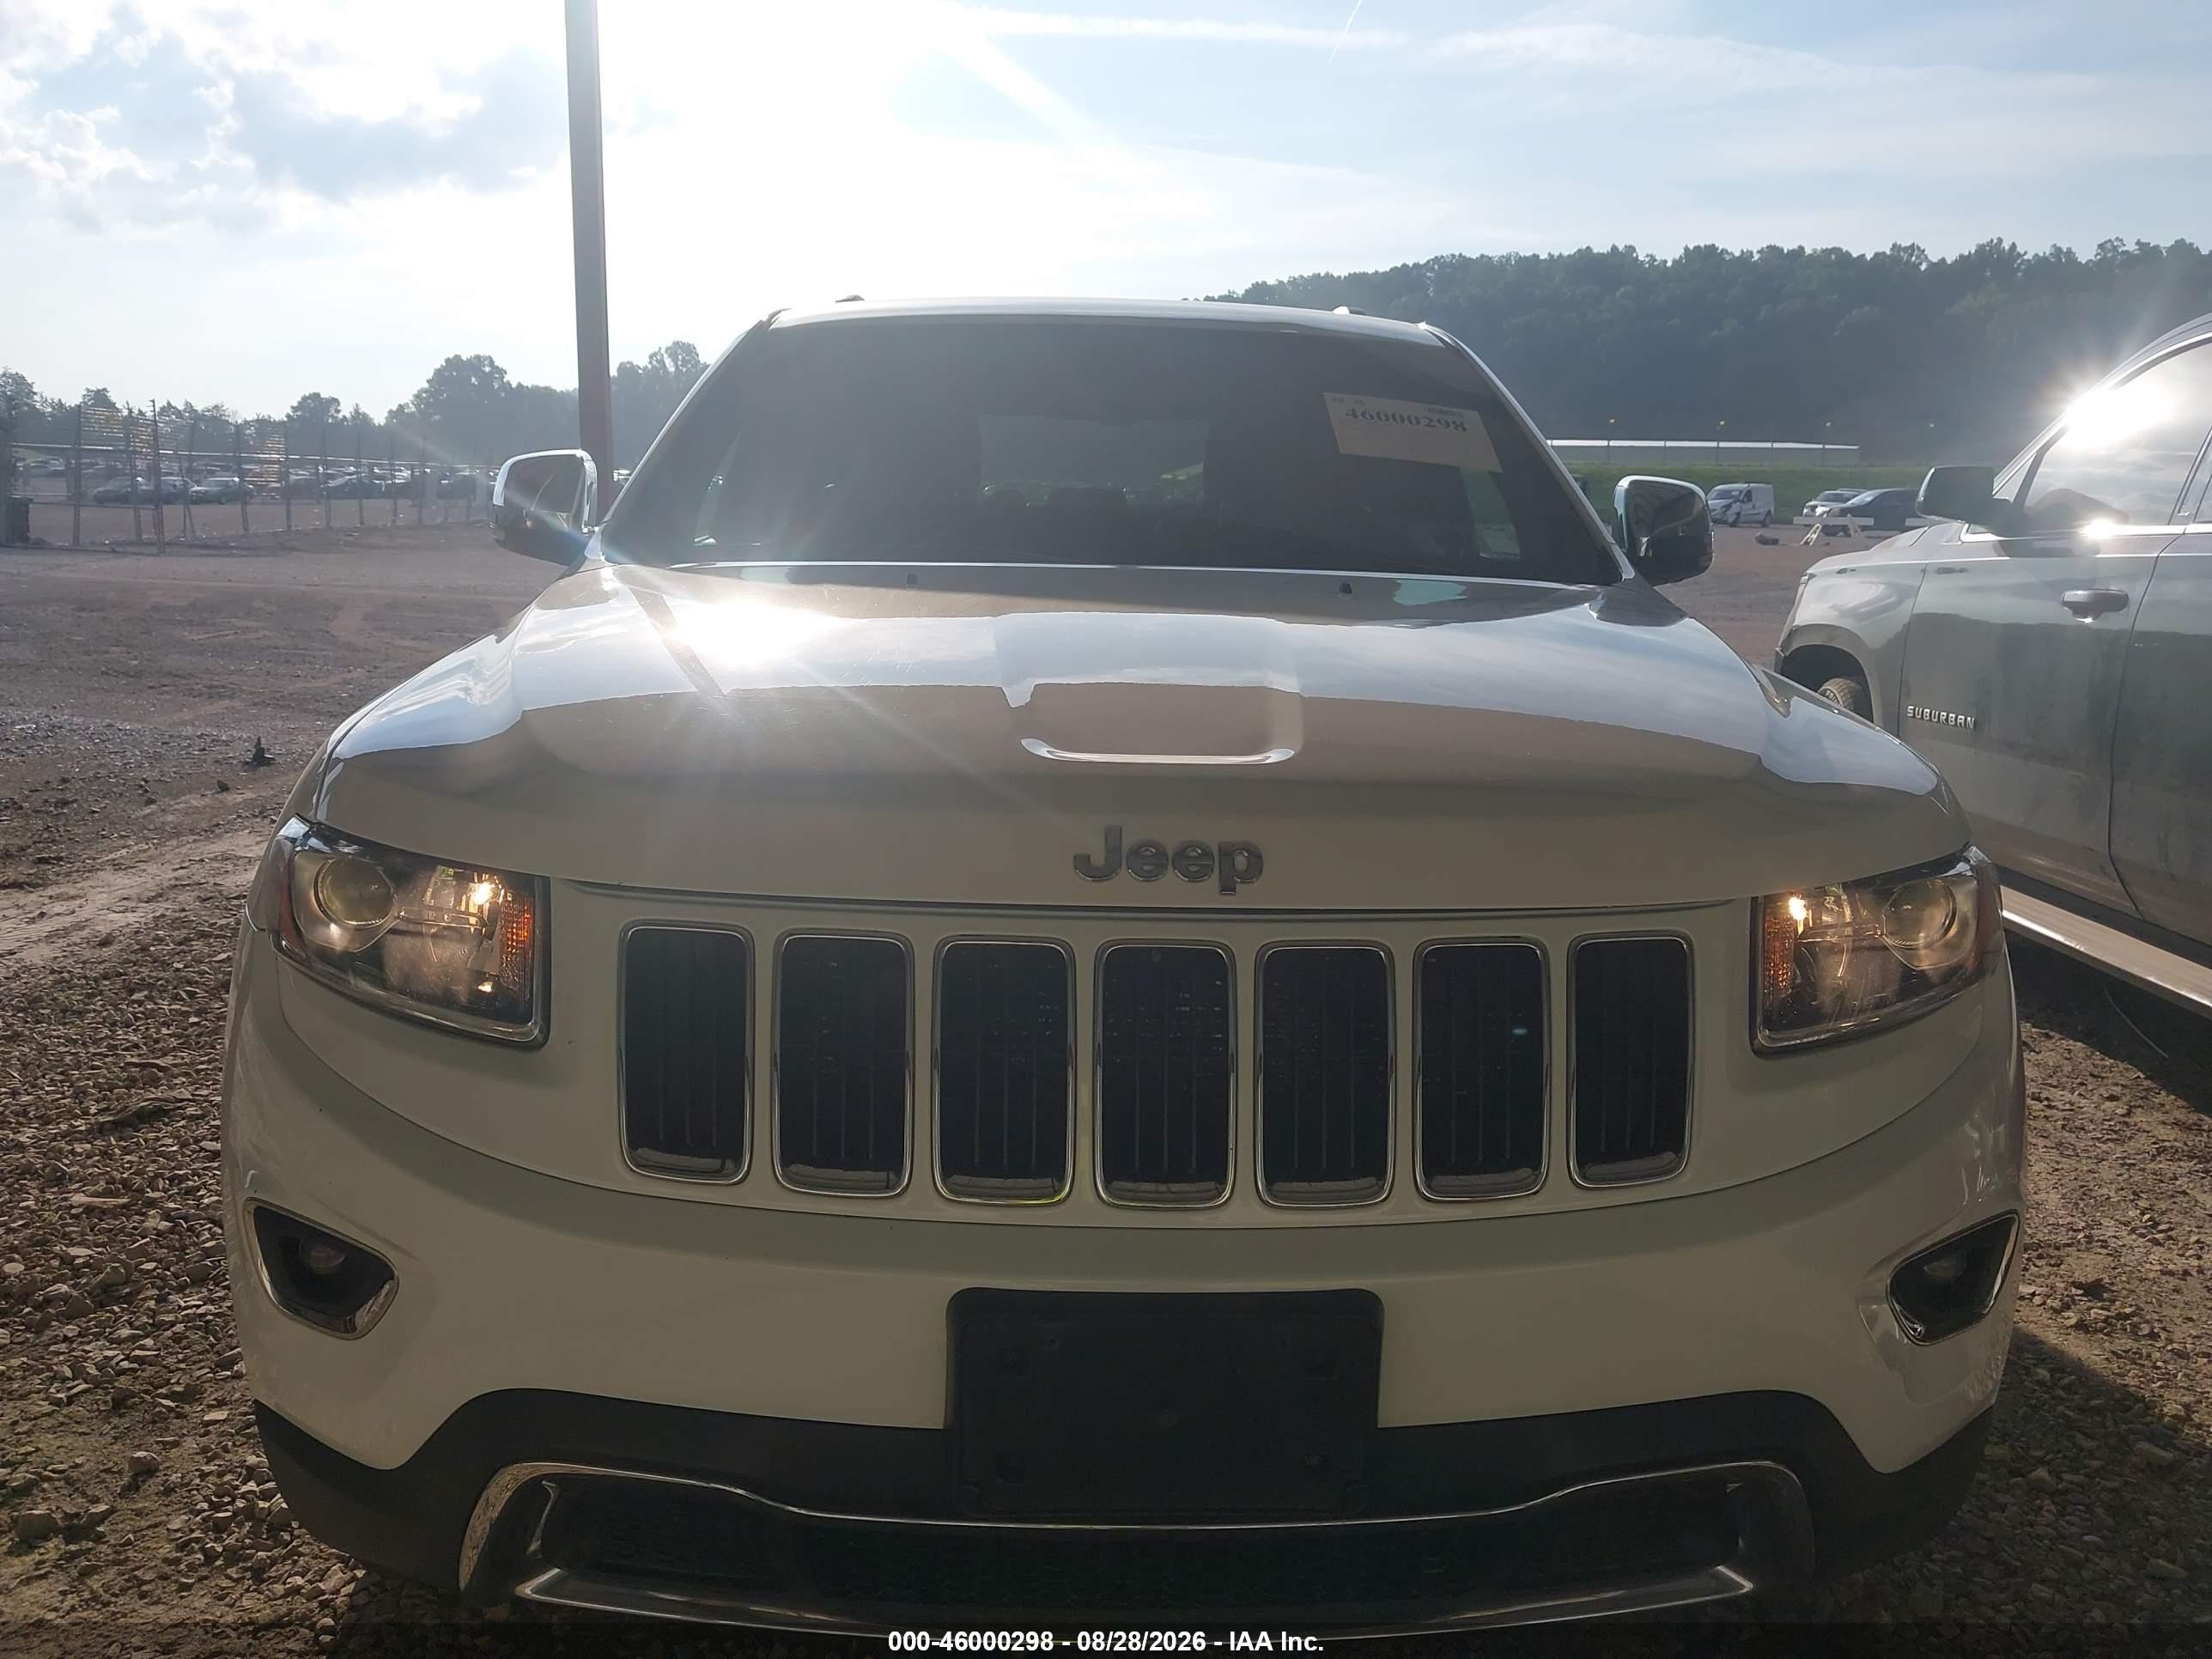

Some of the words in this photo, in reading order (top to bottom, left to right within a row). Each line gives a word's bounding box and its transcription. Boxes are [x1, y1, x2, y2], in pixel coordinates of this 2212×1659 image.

[1346, 408, 1468, 432] 46000298
[1907, 705, 1975, 729] SUBURBAN
[1073, 824, 1264, 896] Jeep
